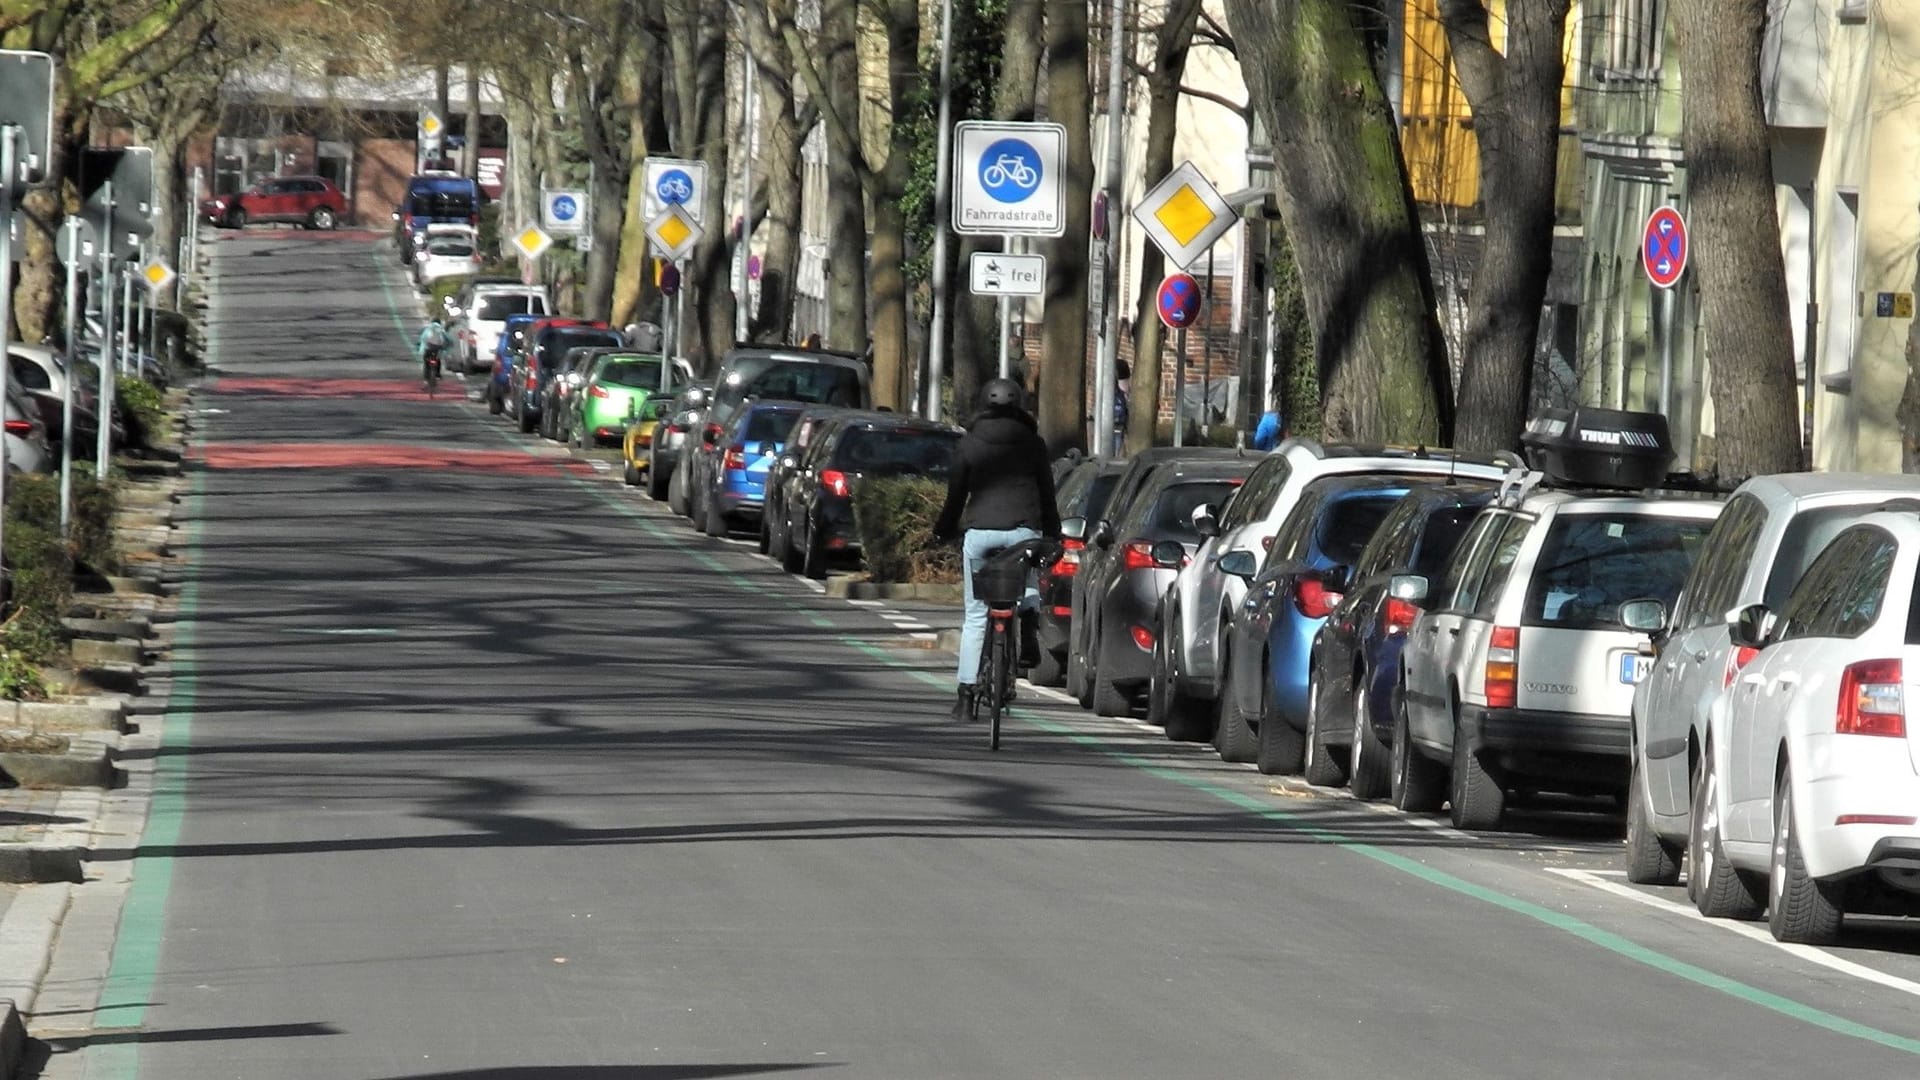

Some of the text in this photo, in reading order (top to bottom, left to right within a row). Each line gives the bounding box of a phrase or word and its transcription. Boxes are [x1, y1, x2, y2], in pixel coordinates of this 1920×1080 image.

[965, 208, 1053, 221] Fahrradstraße
[1011, 268, 1037, 281] frei
[1580, 429, 1620, 445] THULE
[1524, 682, 1577, 694] VOLVO
